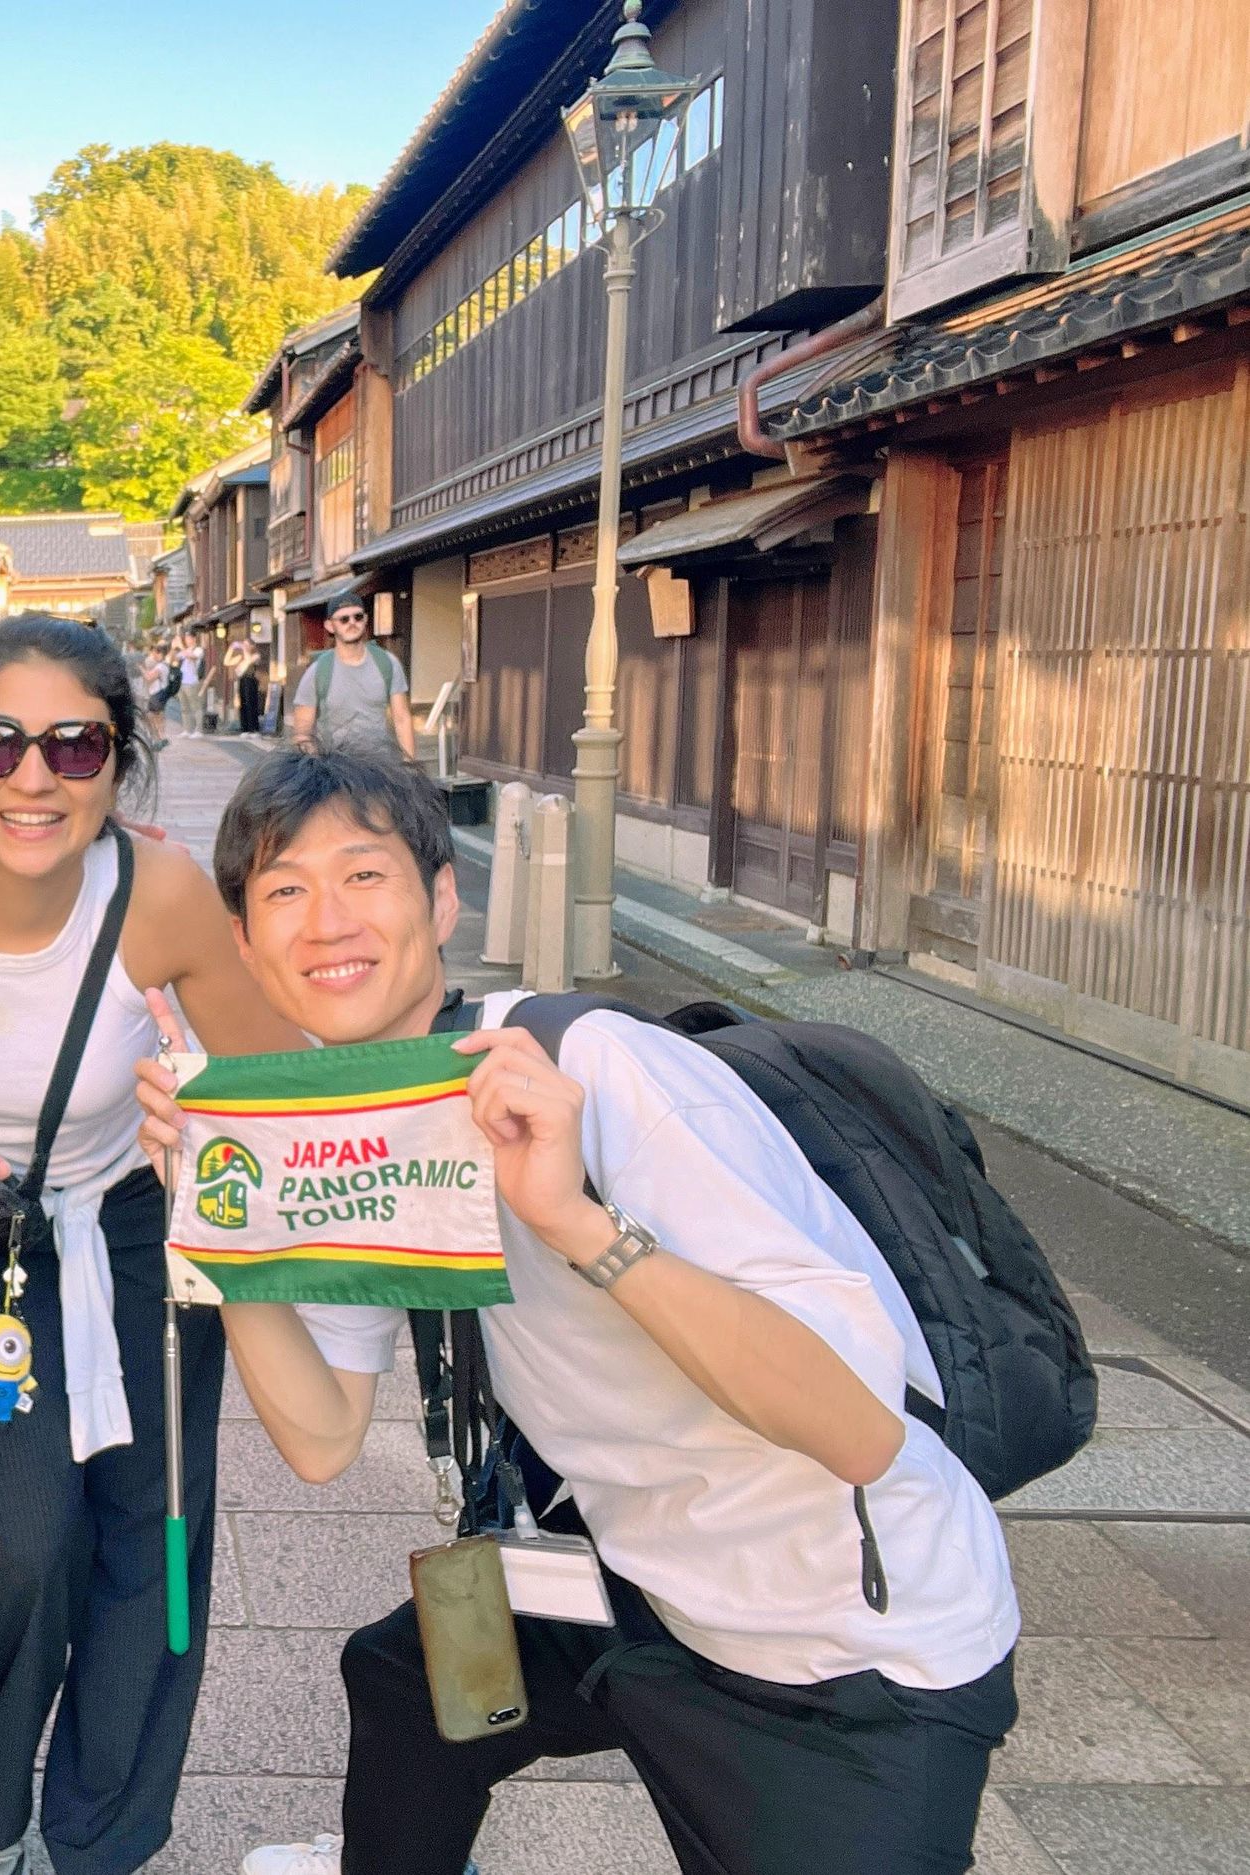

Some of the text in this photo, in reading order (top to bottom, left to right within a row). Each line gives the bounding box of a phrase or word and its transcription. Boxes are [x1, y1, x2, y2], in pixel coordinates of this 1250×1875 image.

[284, 1137, 389, 1168] JAPAN
[279, 1160, 478, 1202] PANORAMIC
[278, 1196, 397, 1231] TOURS
